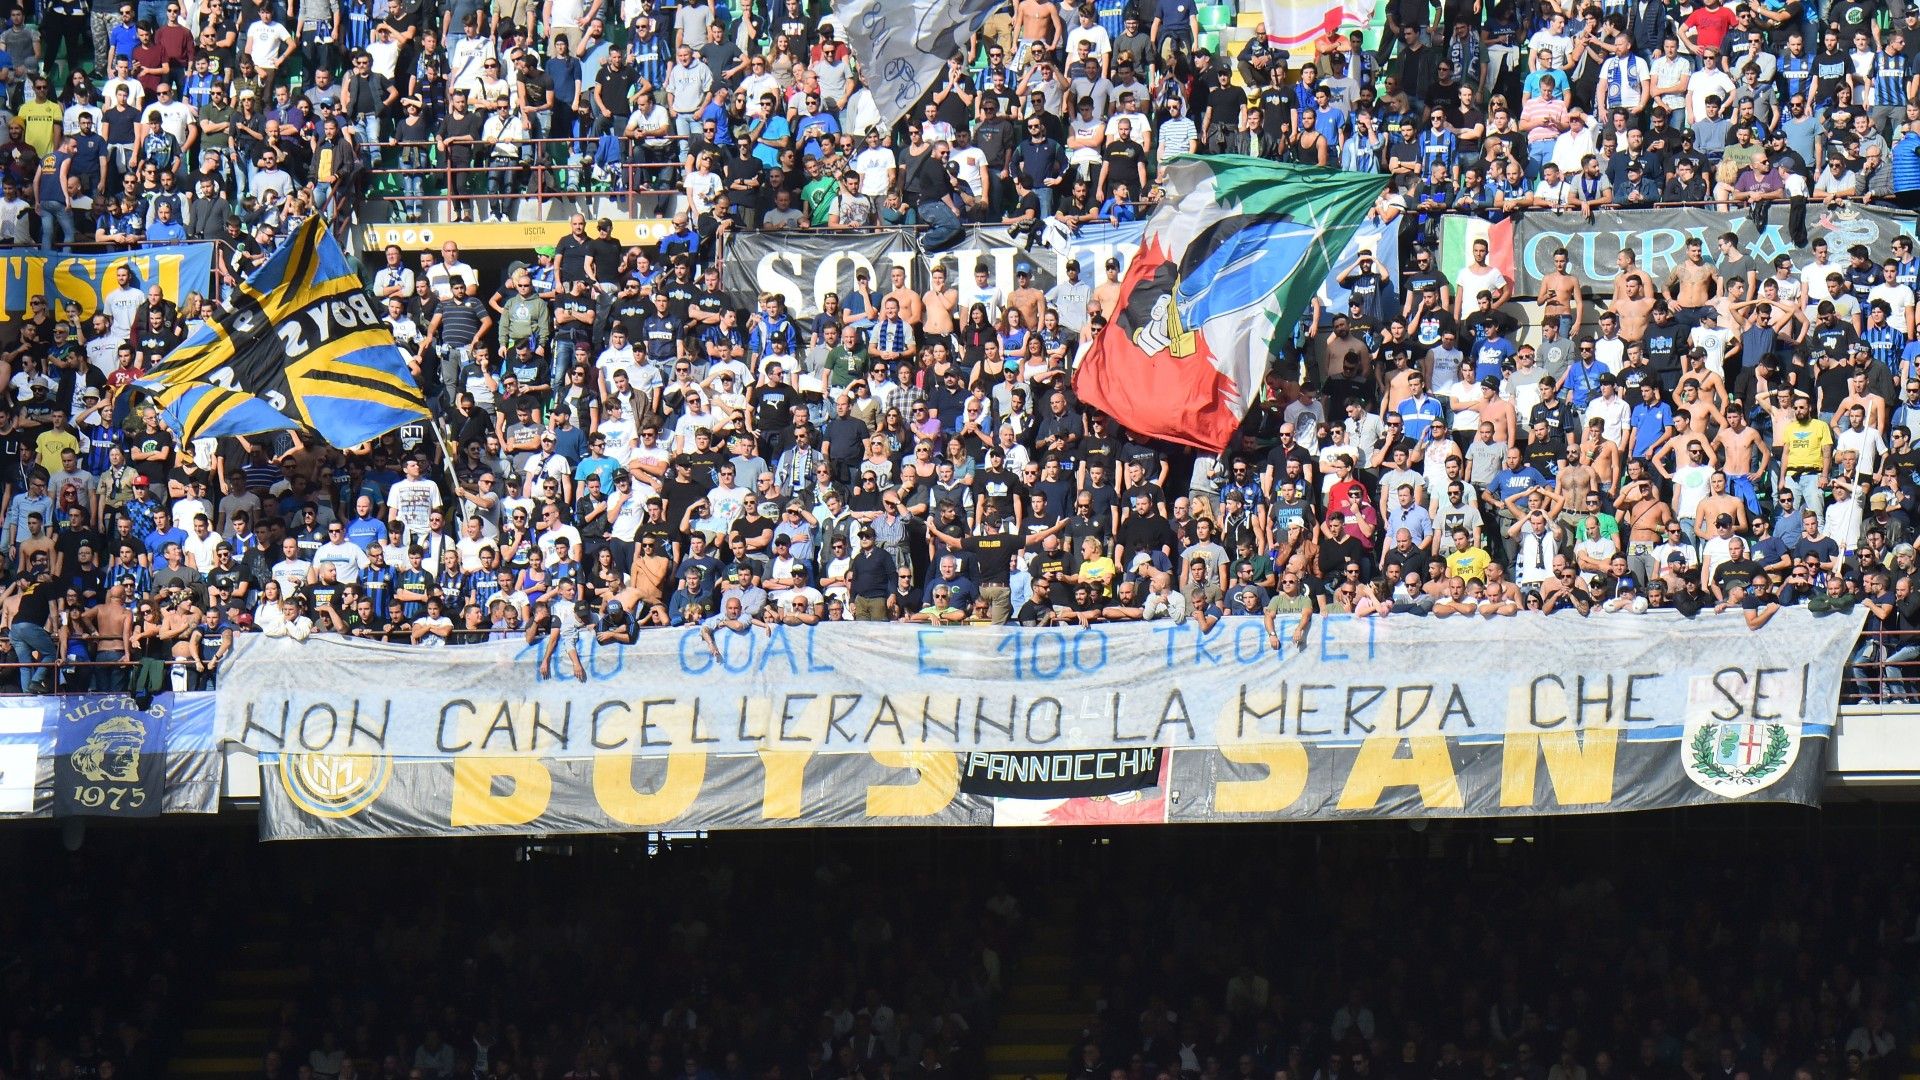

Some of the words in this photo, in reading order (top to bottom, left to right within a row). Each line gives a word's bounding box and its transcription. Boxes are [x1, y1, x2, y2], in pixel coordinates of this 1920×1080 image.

[524, 227, 546, 236] USCITA
[1523, 216, 1803, 282] CURVA
[1508, 476, 1531, 488] NIKE
[1278, 507, 1303, 516] DOMYOS
[678, 623, 835, 676] GOAL
[917, 629, 950, 676] E
[997, 628, 1108, 683] 100
[241, 698, 392, 752] NON
[436, 692, 1063, 753] CANCELLERANNO
[1112, 688, 1196, 742] LA
[1237, 680, 1476, 738] MERDA
[1529, 672, 1664, 729] CHE
[1711, 662, 1811, 722] SEI
[1213, 692, 1620, 812] SAN
[73, 786, 146, 810] 1975
